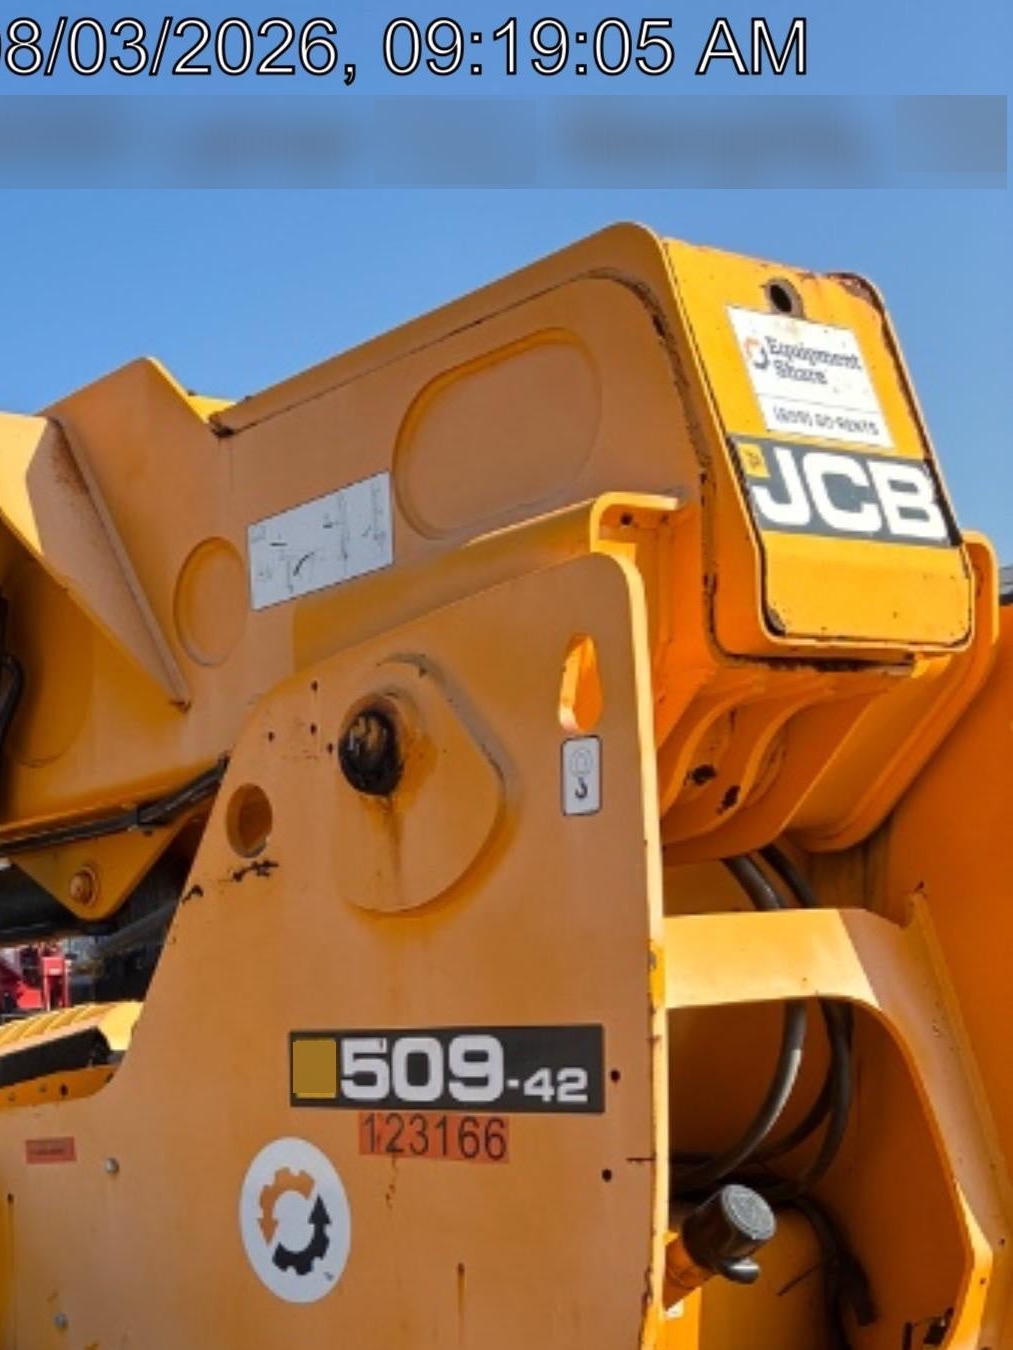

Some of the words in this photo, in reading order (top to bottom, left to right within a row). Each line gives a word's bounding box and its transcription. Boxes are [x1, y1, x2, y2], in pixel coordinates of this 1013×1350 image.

[764, 336, 862, 370] Equipment
[773, 360, 828, 385] Share
[751, 446, 949, 541] JCB
[340, 1034, 588, 1103] 509-42
[362, 1113, 507, 1161] 123166
